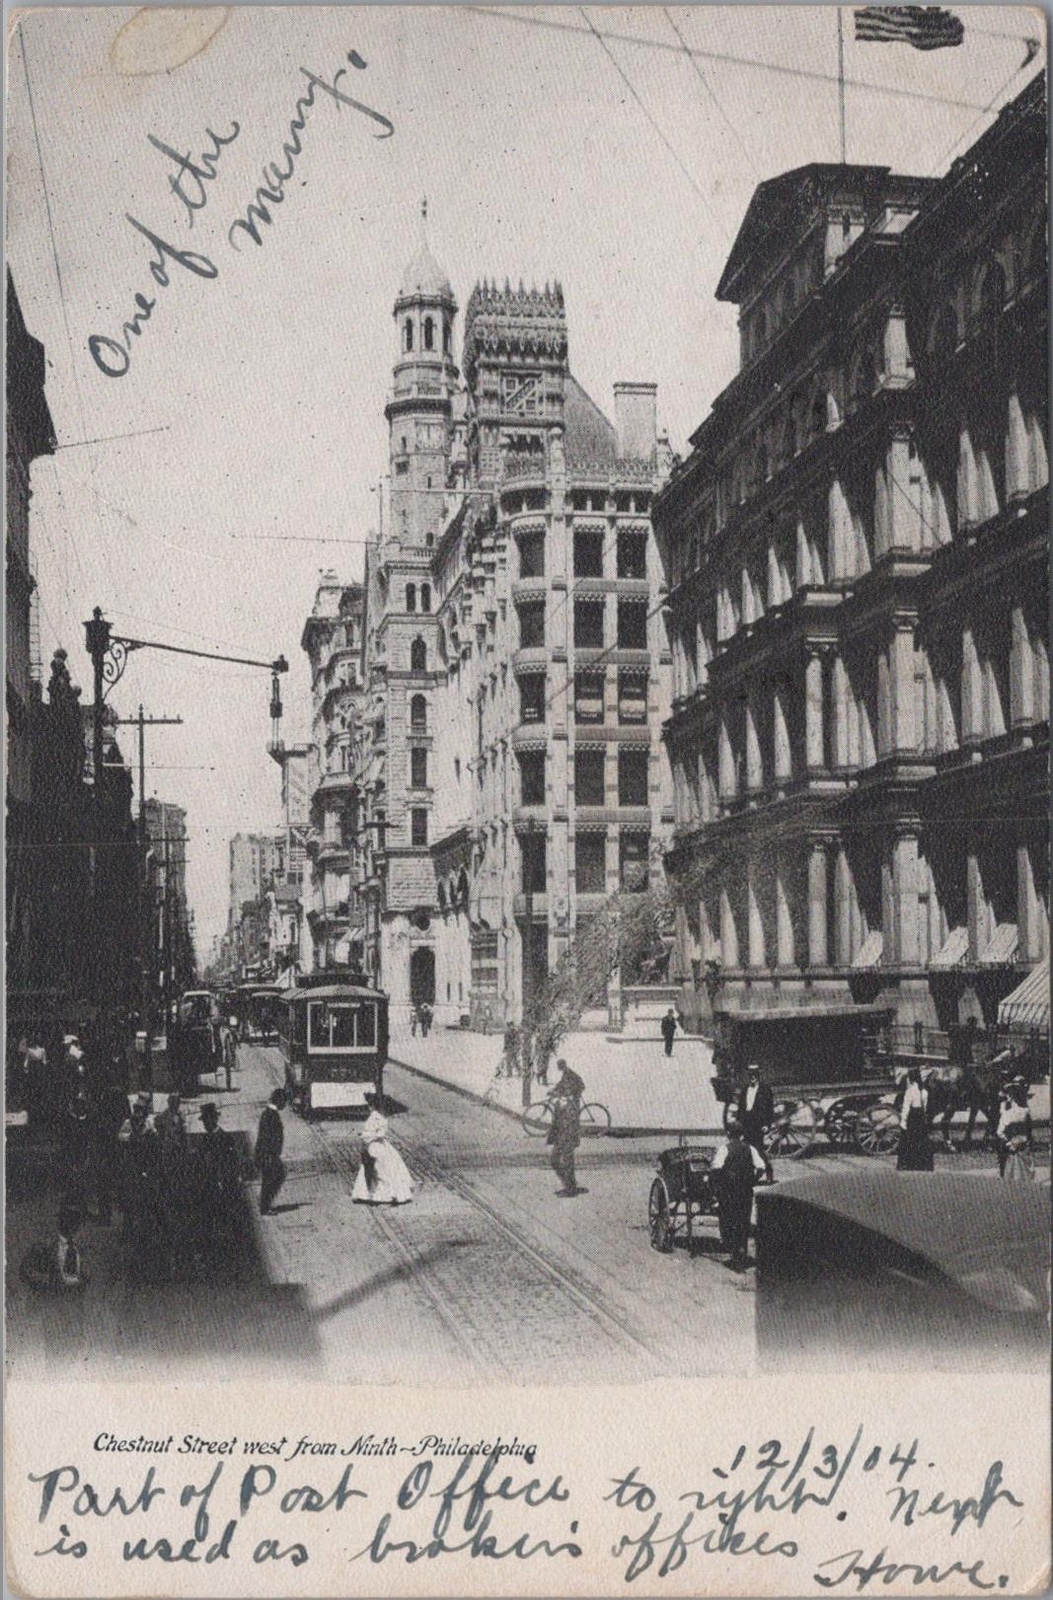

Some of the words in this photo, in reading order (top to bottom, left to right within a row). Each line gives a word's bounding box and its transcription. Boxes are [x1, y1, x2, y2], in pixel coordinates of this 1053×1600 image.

[147, 119, 241, 230] the
[125, 211, 219, 288] of
[88, 292, 156, 378] One
[27, 1465, 166, 1524] Part
[179, 1460, 225, 1544] of
[239, 1464, 368, 1518] Post
[395, 1445, 571, 1539] Office
[602, 1466, 657, 1513] to
[33, 1524, 89, 1560] is
[121, 1519, 238, 1564] used
[252, 1541, 310, 1566] as
